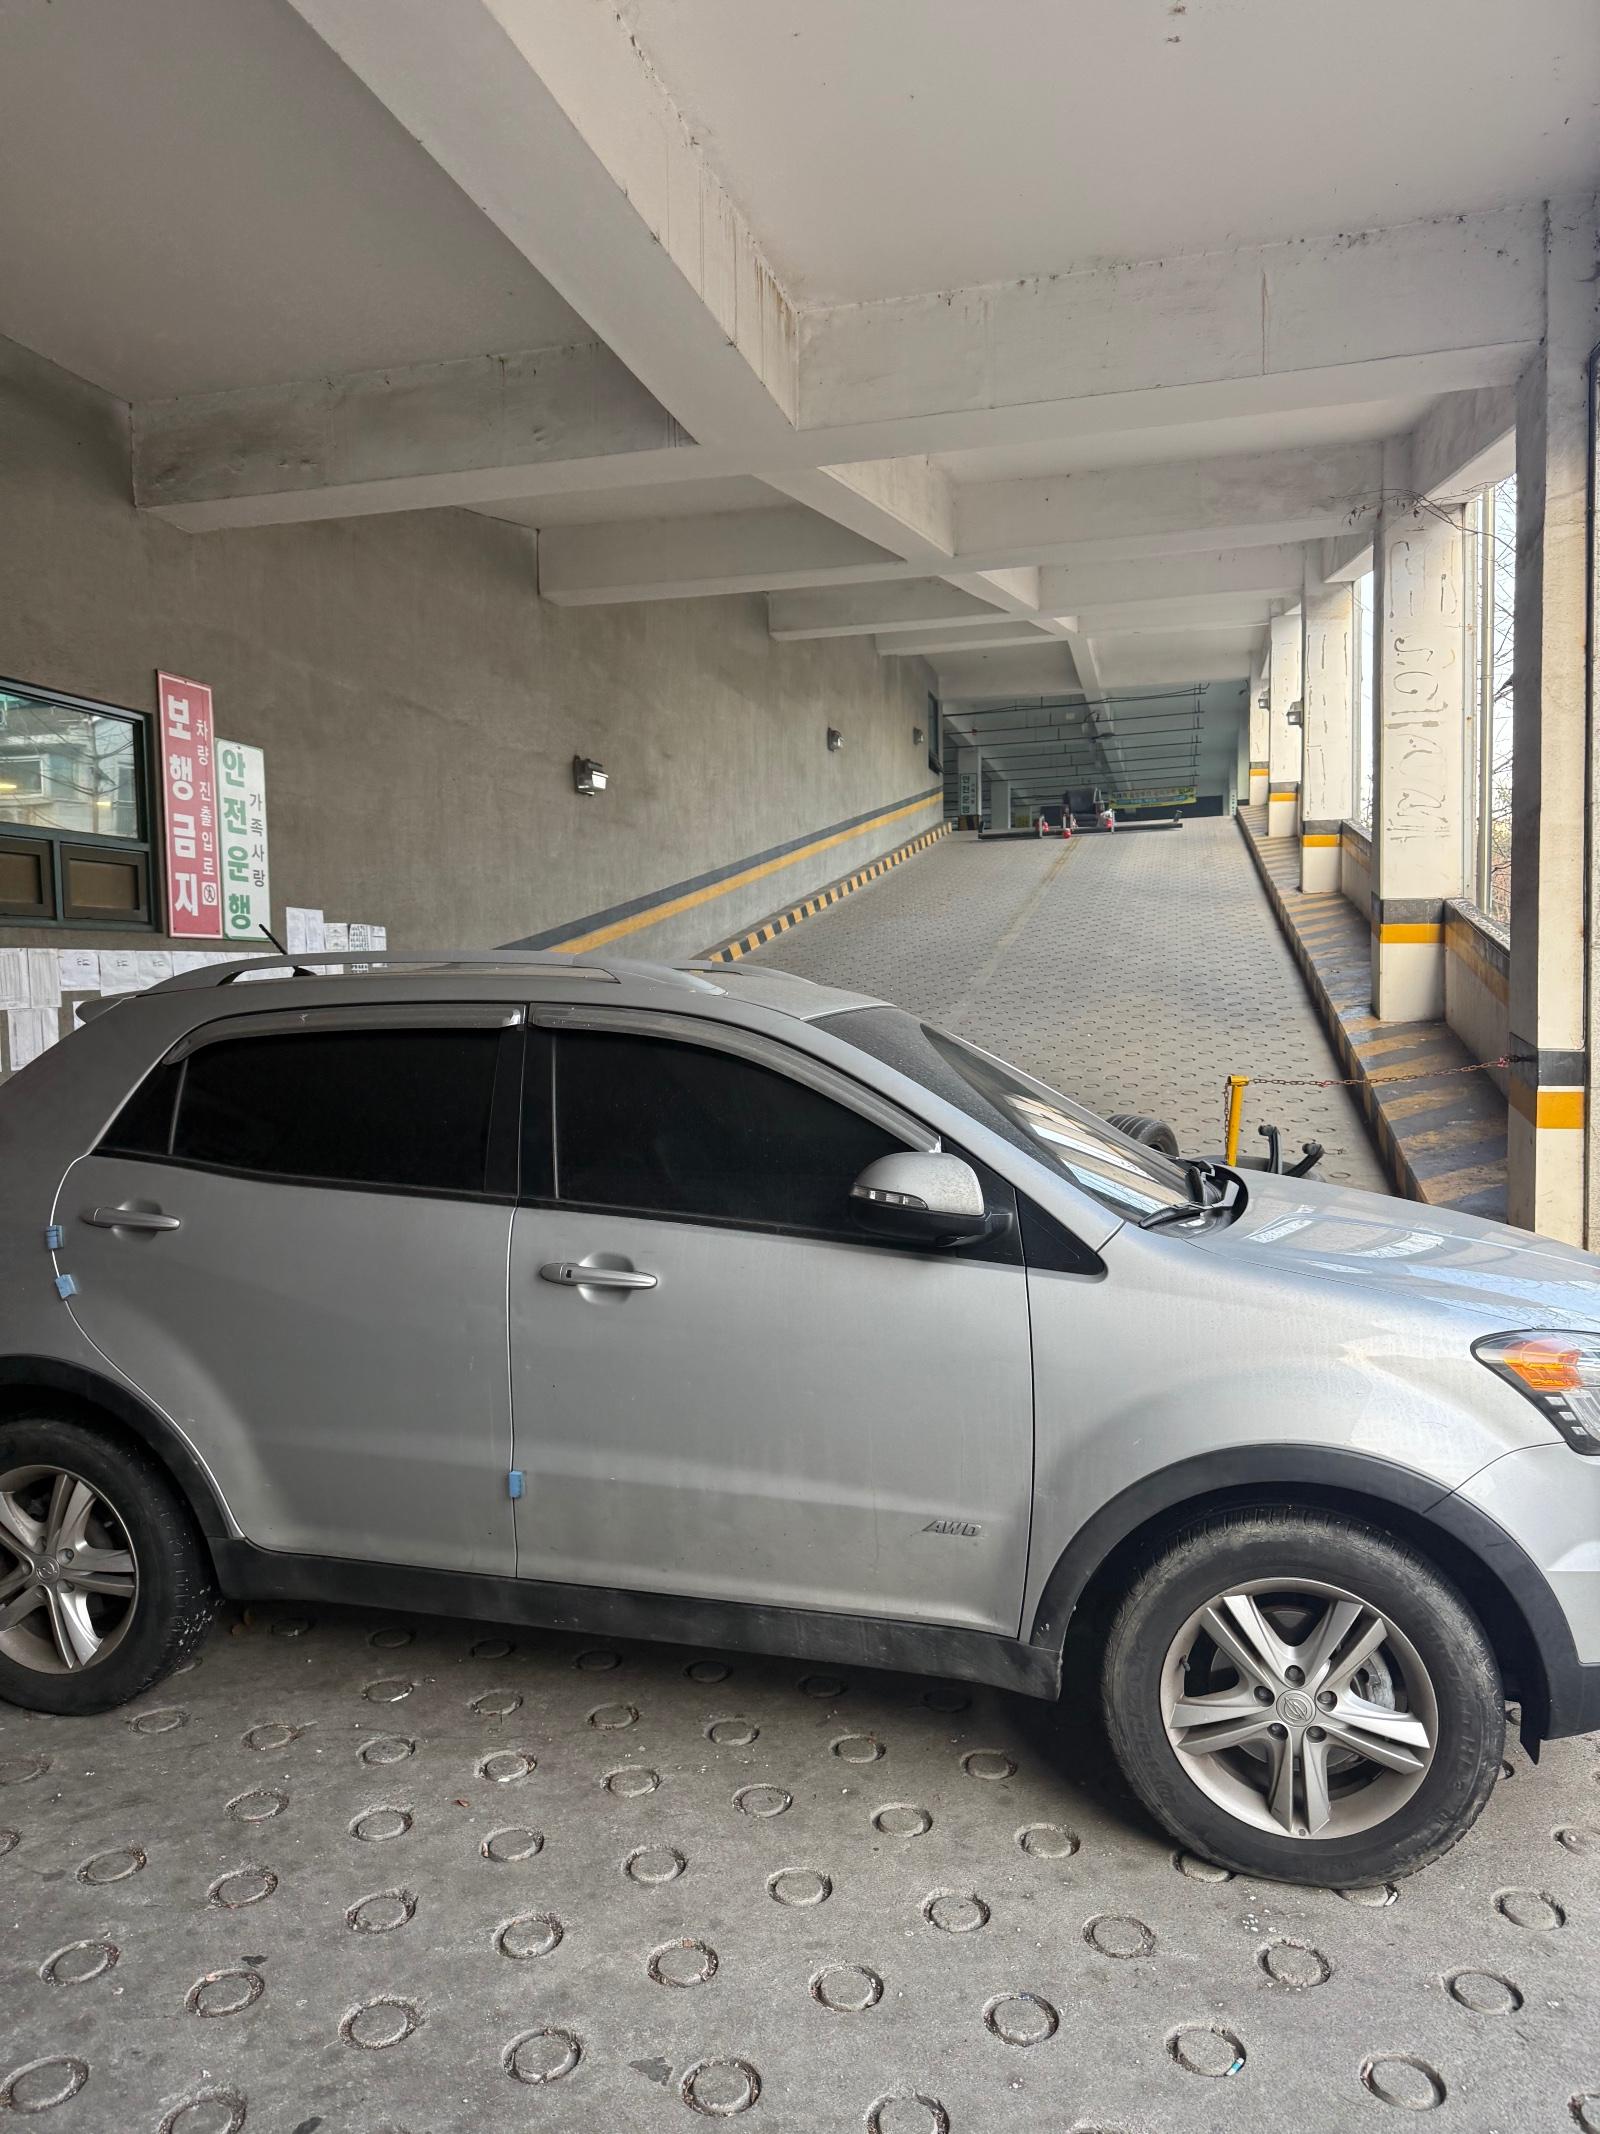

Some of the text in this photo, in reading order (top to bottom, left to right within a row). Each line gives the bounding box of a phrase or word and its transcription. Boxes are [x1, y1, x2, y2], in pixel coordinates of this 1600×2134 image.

[167, 693, 199, 917] 보행금지
[196, 719, 215, 876] 차량 진출입로
[222, 748, 252, 931] 안전운행
[249, 793, 266, 888] 가족사랑
